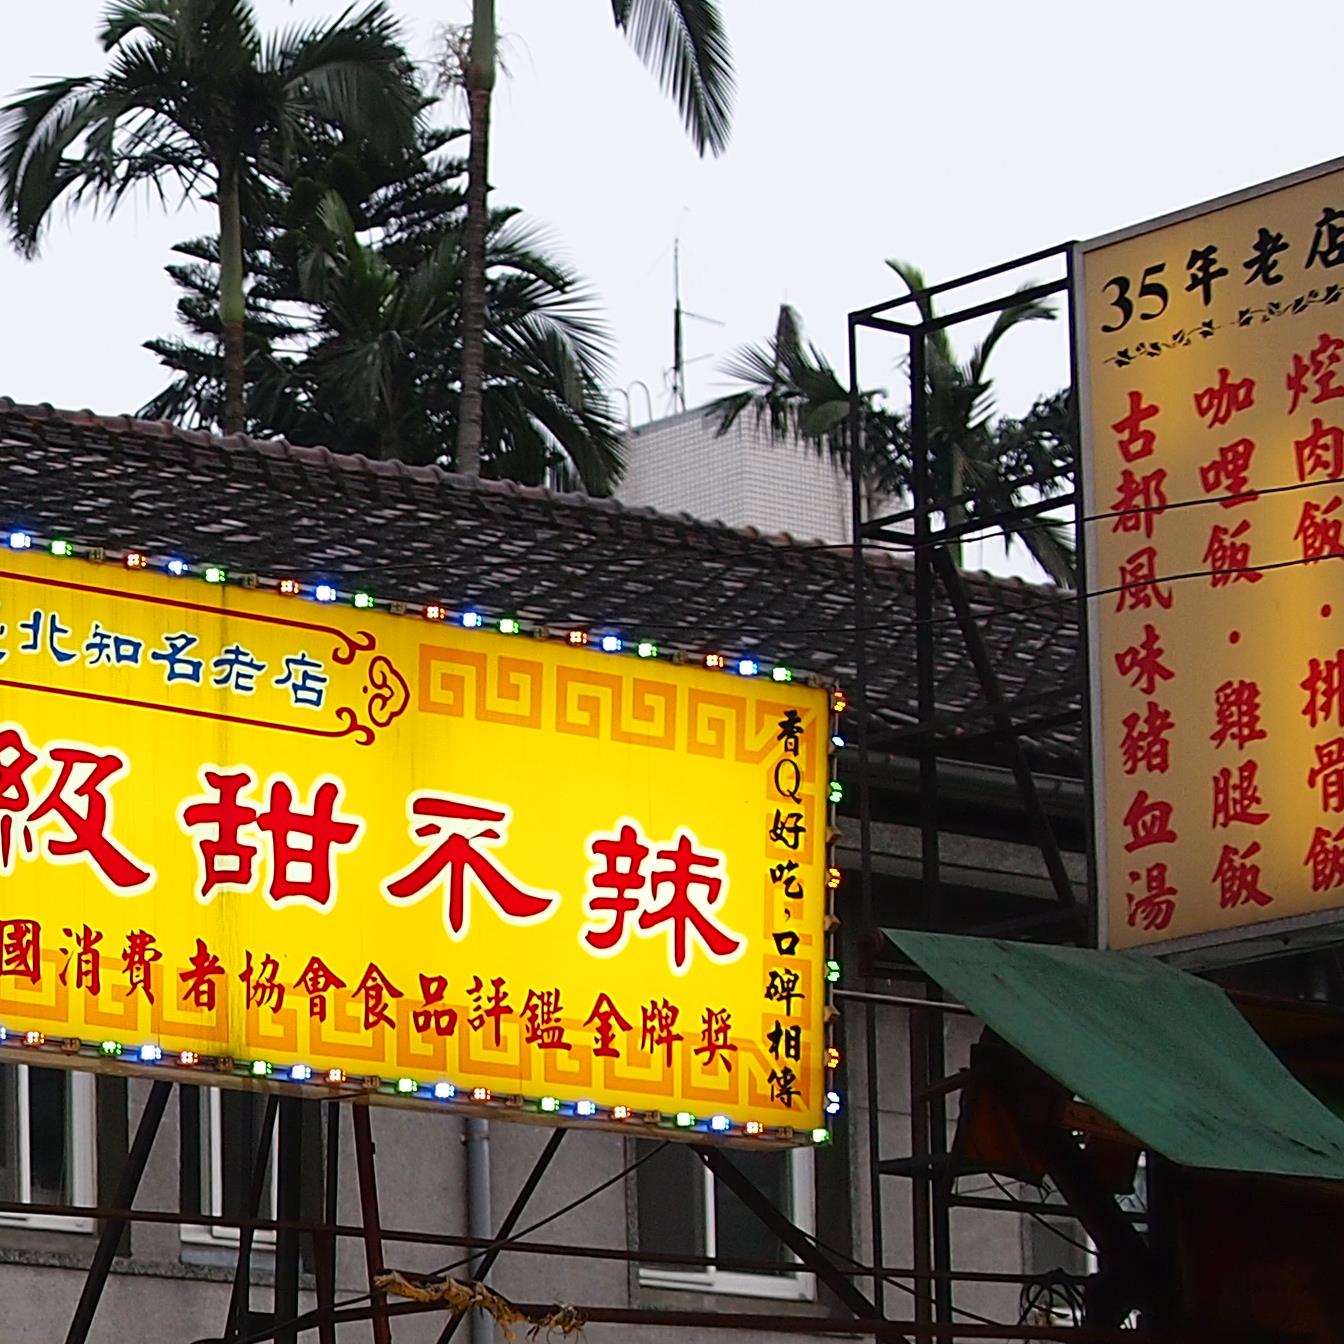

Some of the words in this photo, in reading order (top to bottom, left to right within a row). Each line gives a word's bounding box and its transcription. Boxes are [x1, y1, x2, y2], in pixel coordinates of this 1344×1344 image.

[1100, 207, 1344, 333] 35年老店
[1110, 390, 1179, 932] 古都風味豬血湯
